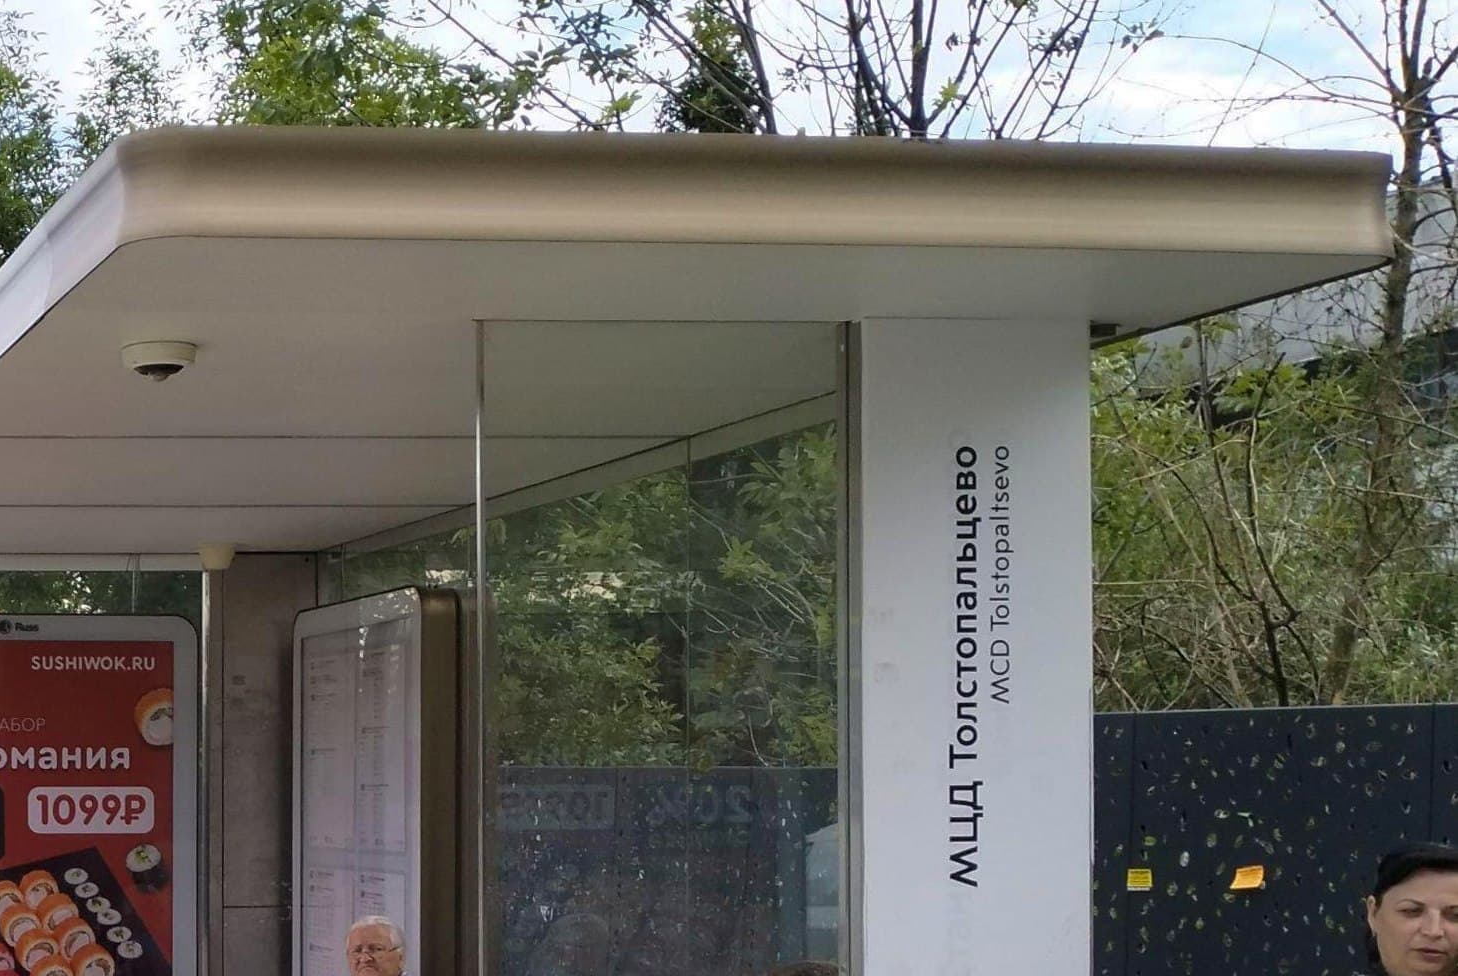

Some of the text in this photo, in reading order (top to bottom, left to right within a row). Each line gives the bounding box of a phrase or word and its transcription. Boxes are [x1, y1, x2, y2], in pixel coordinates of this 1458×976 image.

[31, 655, 156, 671] SUSHIWOK.RU
[948, 445, 983, 888] МЦД Толстопальцево
[989, 445, 1014, 704] MCD Tolstopaltsevo
